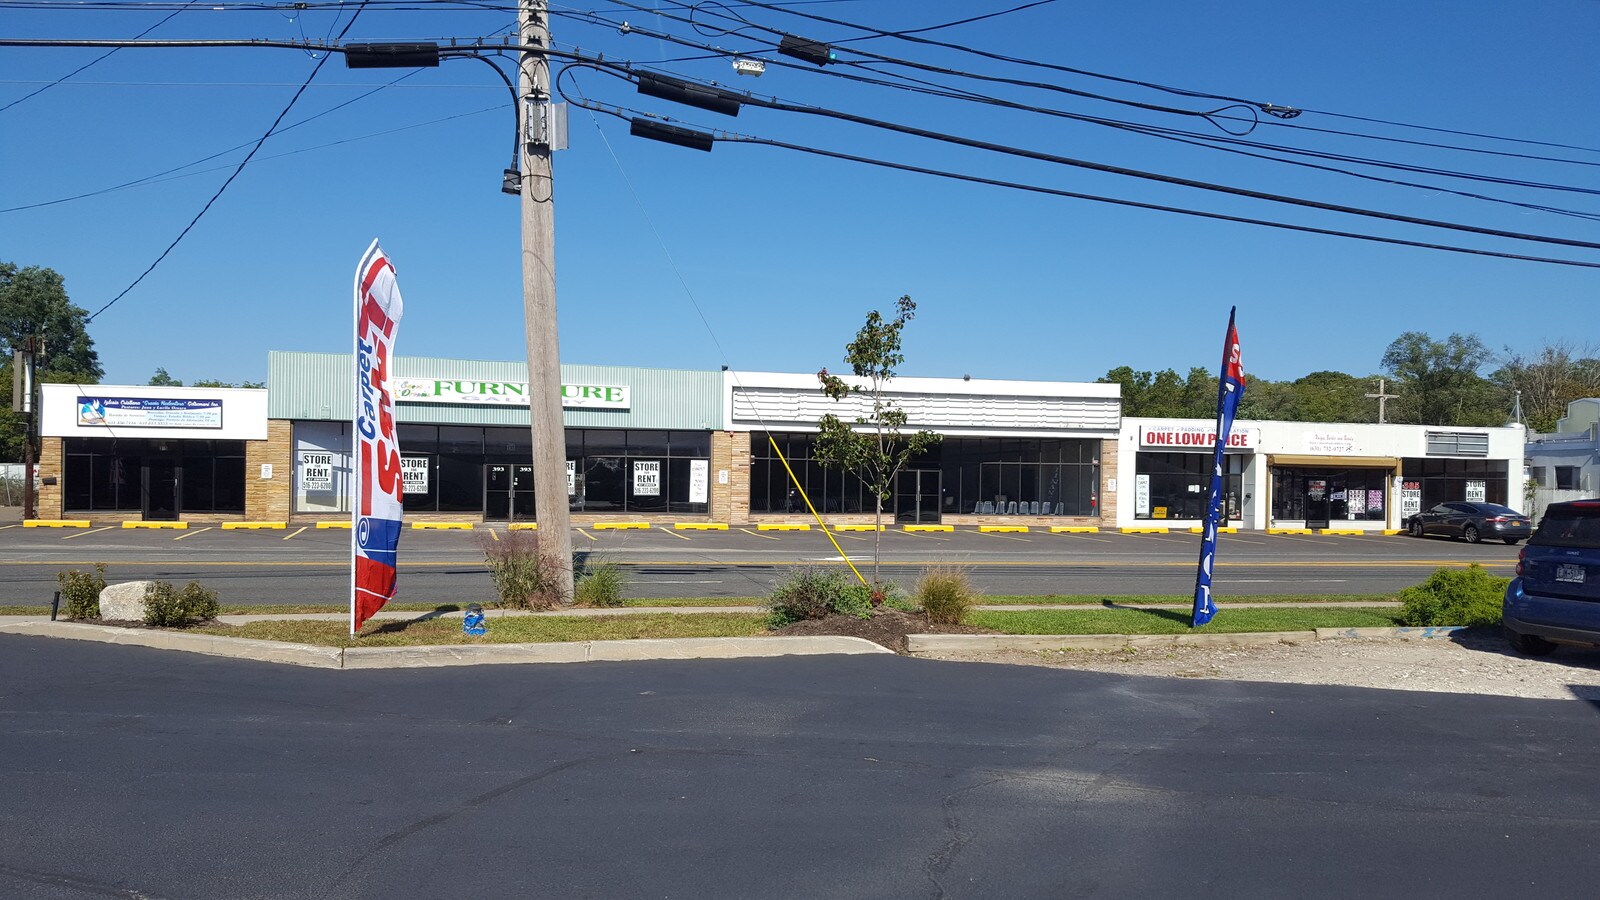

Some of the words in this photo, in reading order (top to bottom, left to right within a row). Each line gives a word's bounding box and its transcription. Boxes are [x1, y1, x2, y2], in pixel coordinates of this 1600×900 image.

[358, 338, 376, 440] Carpet
[434, 380, 624, 402] FURNURE
[1146, 431, 1173, 445] ONE
[1175, 432, 1206, 446] LOW
[1207, 433, 1248, 447] PICE
[303, 455, 332, 464] STORE
[401, 459, 427, 468] STORE
[635, 463, 659, 471] STORE
[306, 468, 329, 477] RENT
[404, 472, 424, 480] RENT
[1402, 490, 1420, 498] STORE
[1467, 490, 1483, 498] RENT
